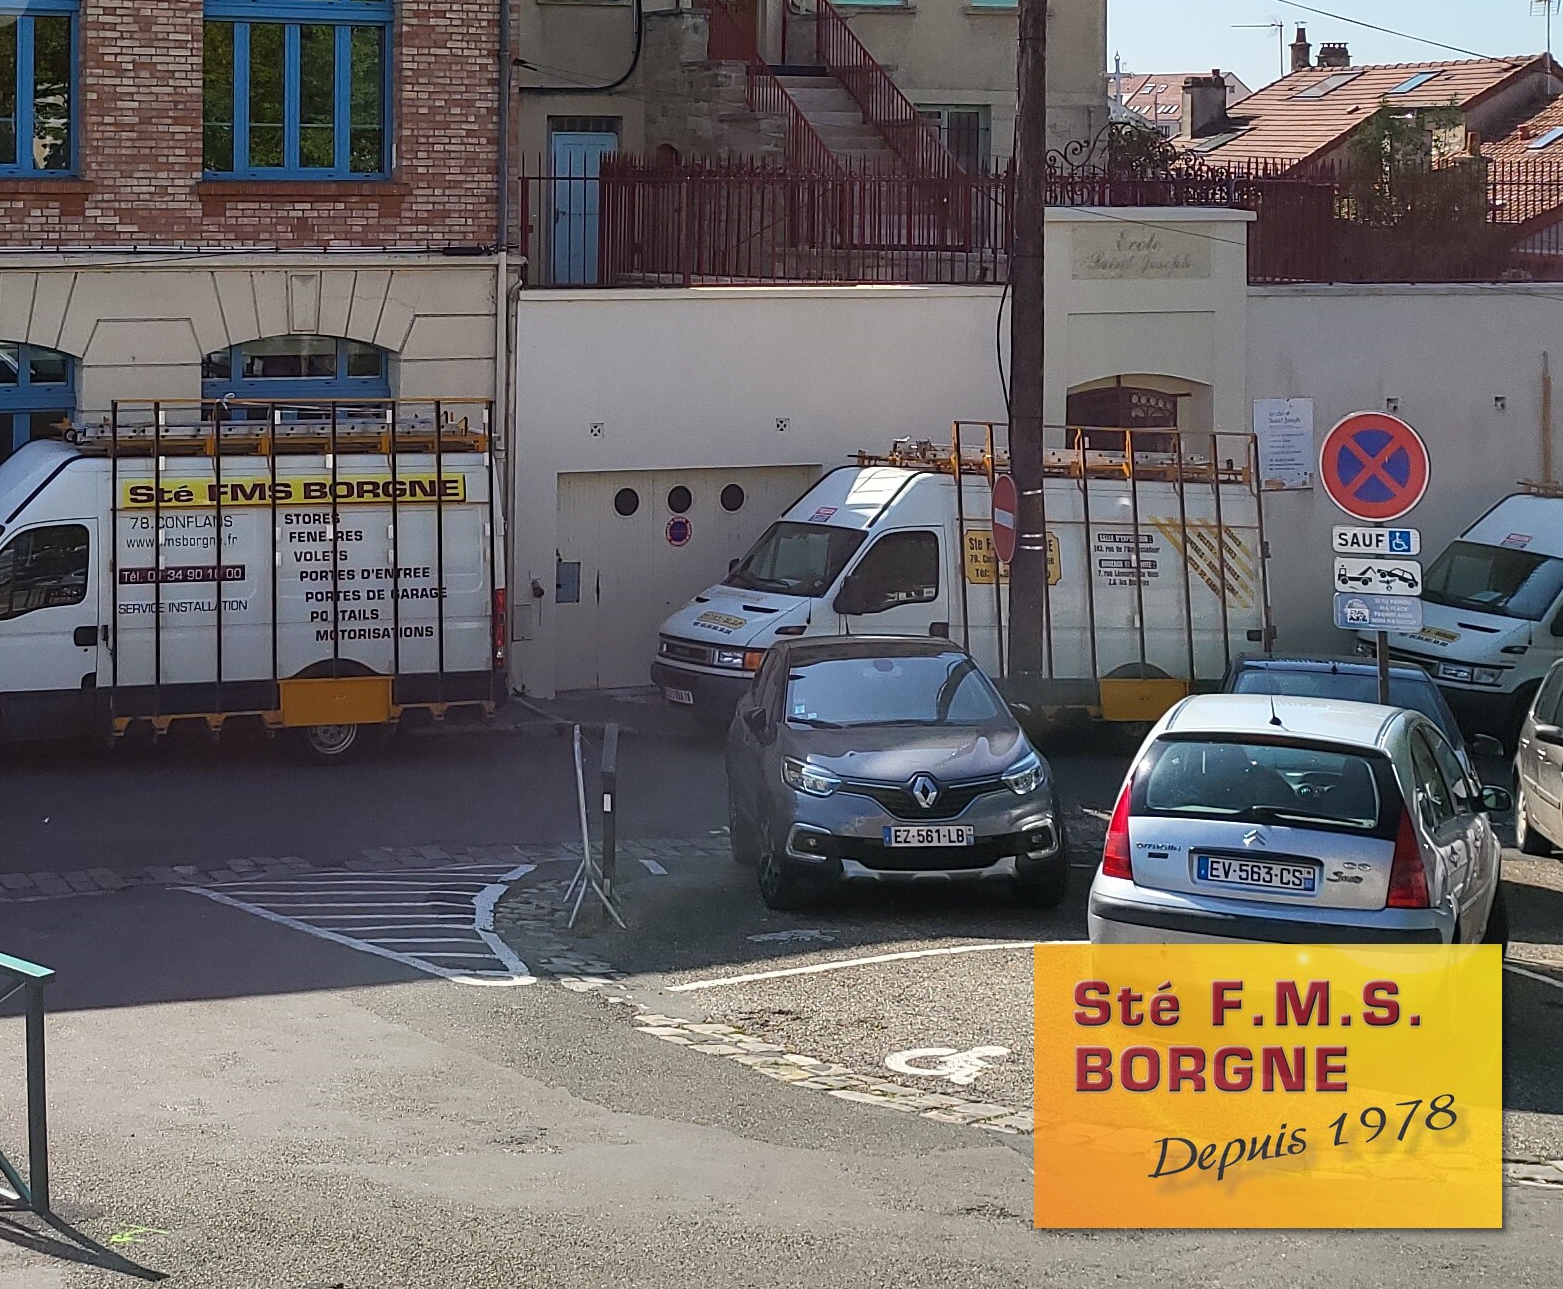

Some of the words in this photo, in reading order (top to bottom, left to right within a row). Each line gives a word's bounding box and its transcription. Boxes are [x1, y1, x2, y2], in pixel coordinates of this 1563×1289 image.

[129, 485, 194, 504] Sté
[207, 482, 293, 502] FMS
[303, 479, 460, 500] BORGNE
[284, 513, 341, 525] STORES
[126, 533, 238, 548] wwwmsborgn.fr
[289, 530, 363, 543] FENERES
[1338, 532, 1385, 548] SAUF
[122, 570, 143, 582] Tél.
[167, 570, 183, 581] 34
[187, 569, 203, 580] 90
[226, 568, 242, 579] 00
[300, 569, 356, 581] PORTES
[361, 566, 430, 580] D'ENTREE
[305, 590, 361, 602] PORTES
[366, 589, 385, 600] DE
[390, 586, 448, 600] GARAGE
[118, 602, 165, 615] SERVICE
[310, 608, 379, 623] POTAILS
